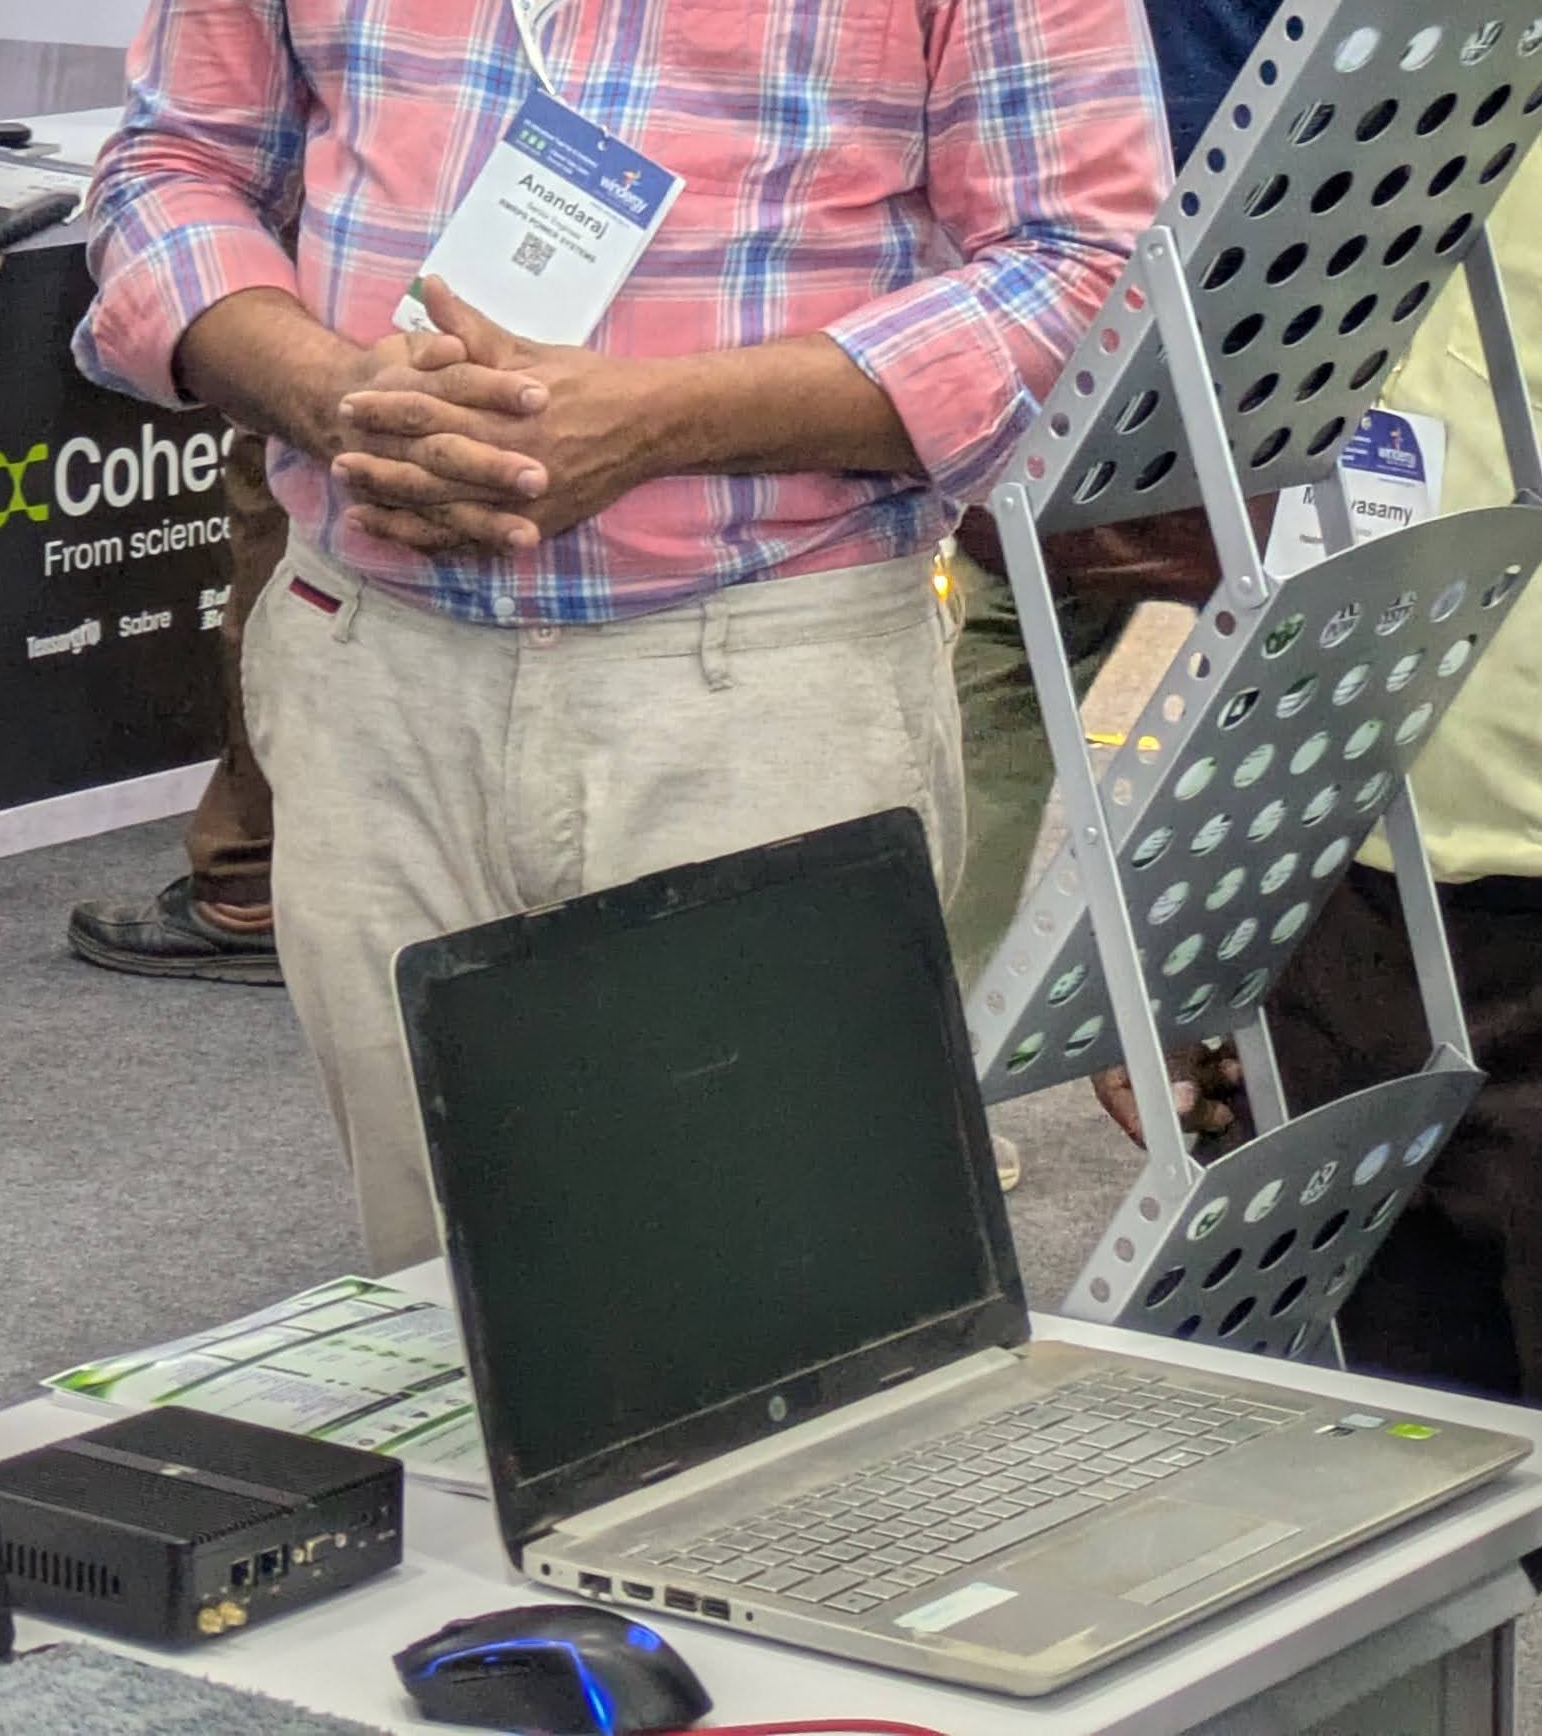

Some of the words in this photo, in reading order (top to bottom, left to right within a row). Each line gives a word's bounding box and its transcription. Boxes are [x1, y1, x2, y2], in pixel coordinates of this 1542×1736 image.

[517, 173, 610, 241] Anandaraj
[44, 536, 124, 578] From
[118, 610, 172, 639] Sabre
